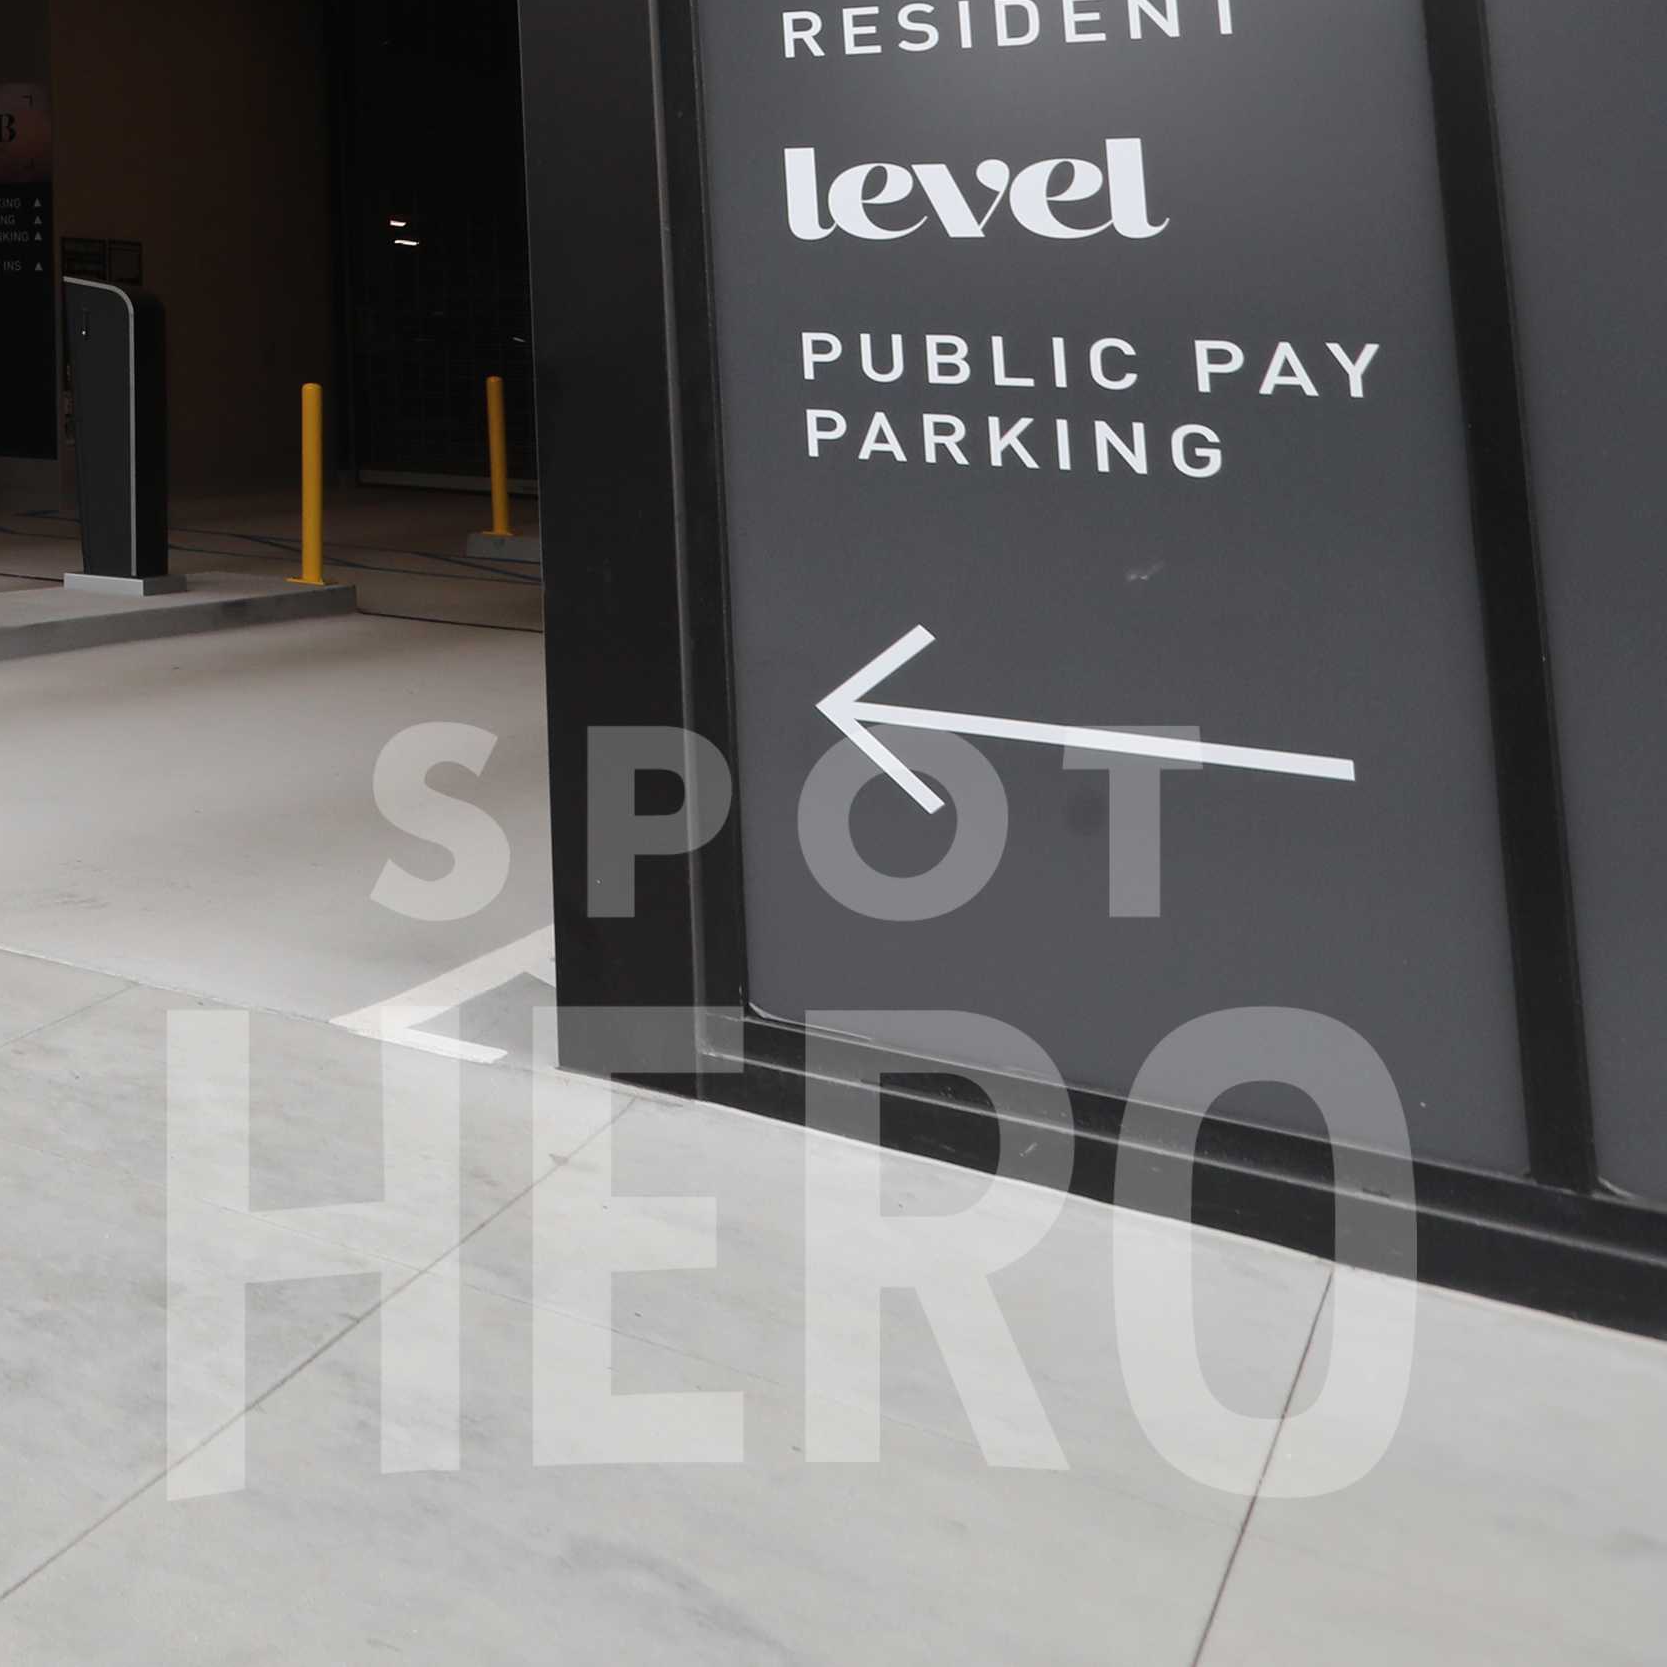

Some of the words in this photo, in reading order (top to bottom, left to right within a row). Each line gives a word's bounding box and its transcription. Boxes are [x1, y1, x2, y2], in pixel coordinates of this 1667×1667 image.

[783, 137, 1170, 241] level
[3, 260, 22, 271] INS
[801, 331, 1138, 391] PUBLIC
[1193, 338, 1381, 398] PAY
[805, 406, 1226, 479] PARKING
